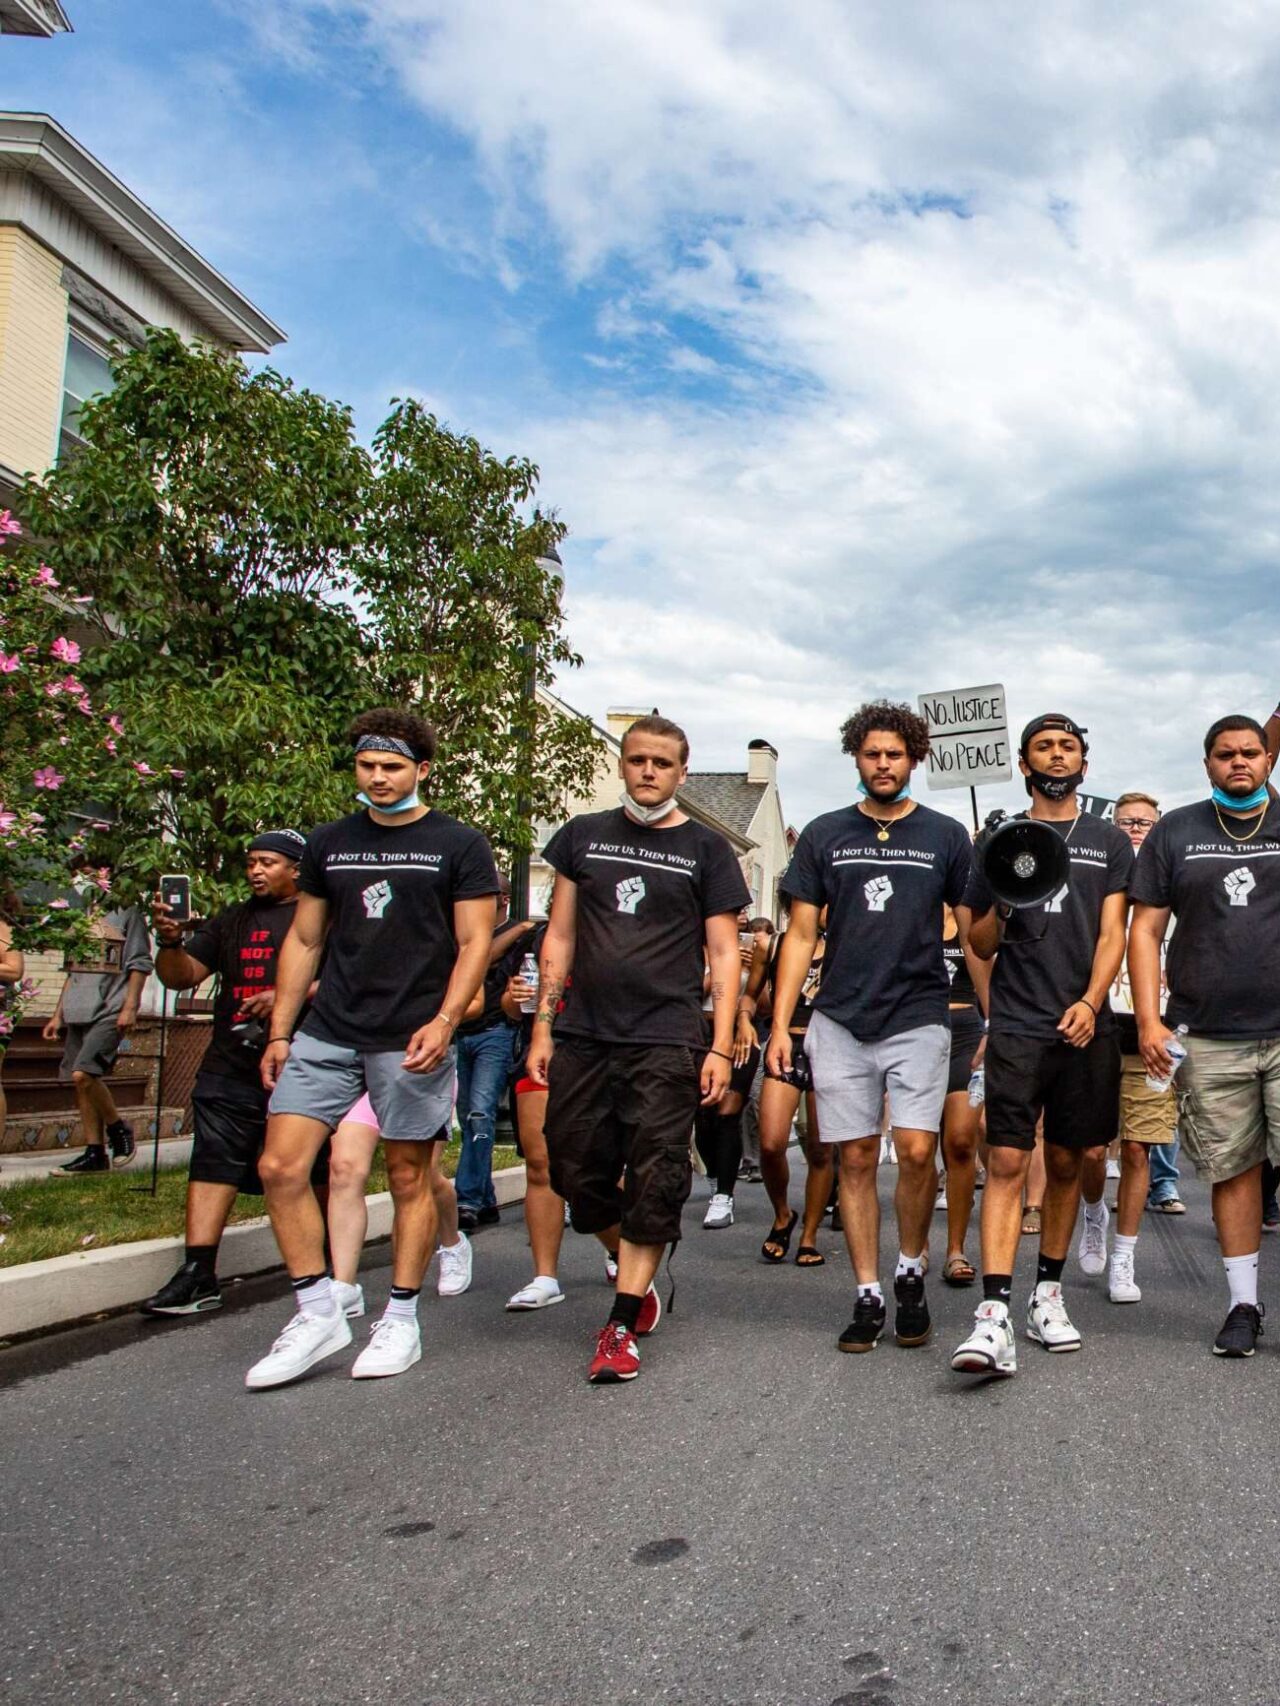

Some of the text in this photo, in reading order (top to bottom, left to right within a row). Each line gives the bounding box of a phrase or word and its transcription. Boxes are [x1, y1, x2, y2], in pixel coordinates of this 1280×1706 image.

[924, 696, 1003, 725] NO JUSTICE
[929, 742, 1006, 773] NO PEACE
[832, 847, 935, 861] IF NOT US, THEN WHO?
[1080, 847, 1107, 859] WHO?
[1195, 843, 1217, 852] NOT
[1218, 844, 1234, 853] US,
[327, 852, 442, 864] IF NOT US, THEN WHO?
[589, 842, 697, 868] IF NOT US, THEN WHO?
[250, 930, 271, 942] IF
[240, 948, 275, 960] NOT
[243, 966, 265, 978] US
[233, 985, 273, 999] THE
